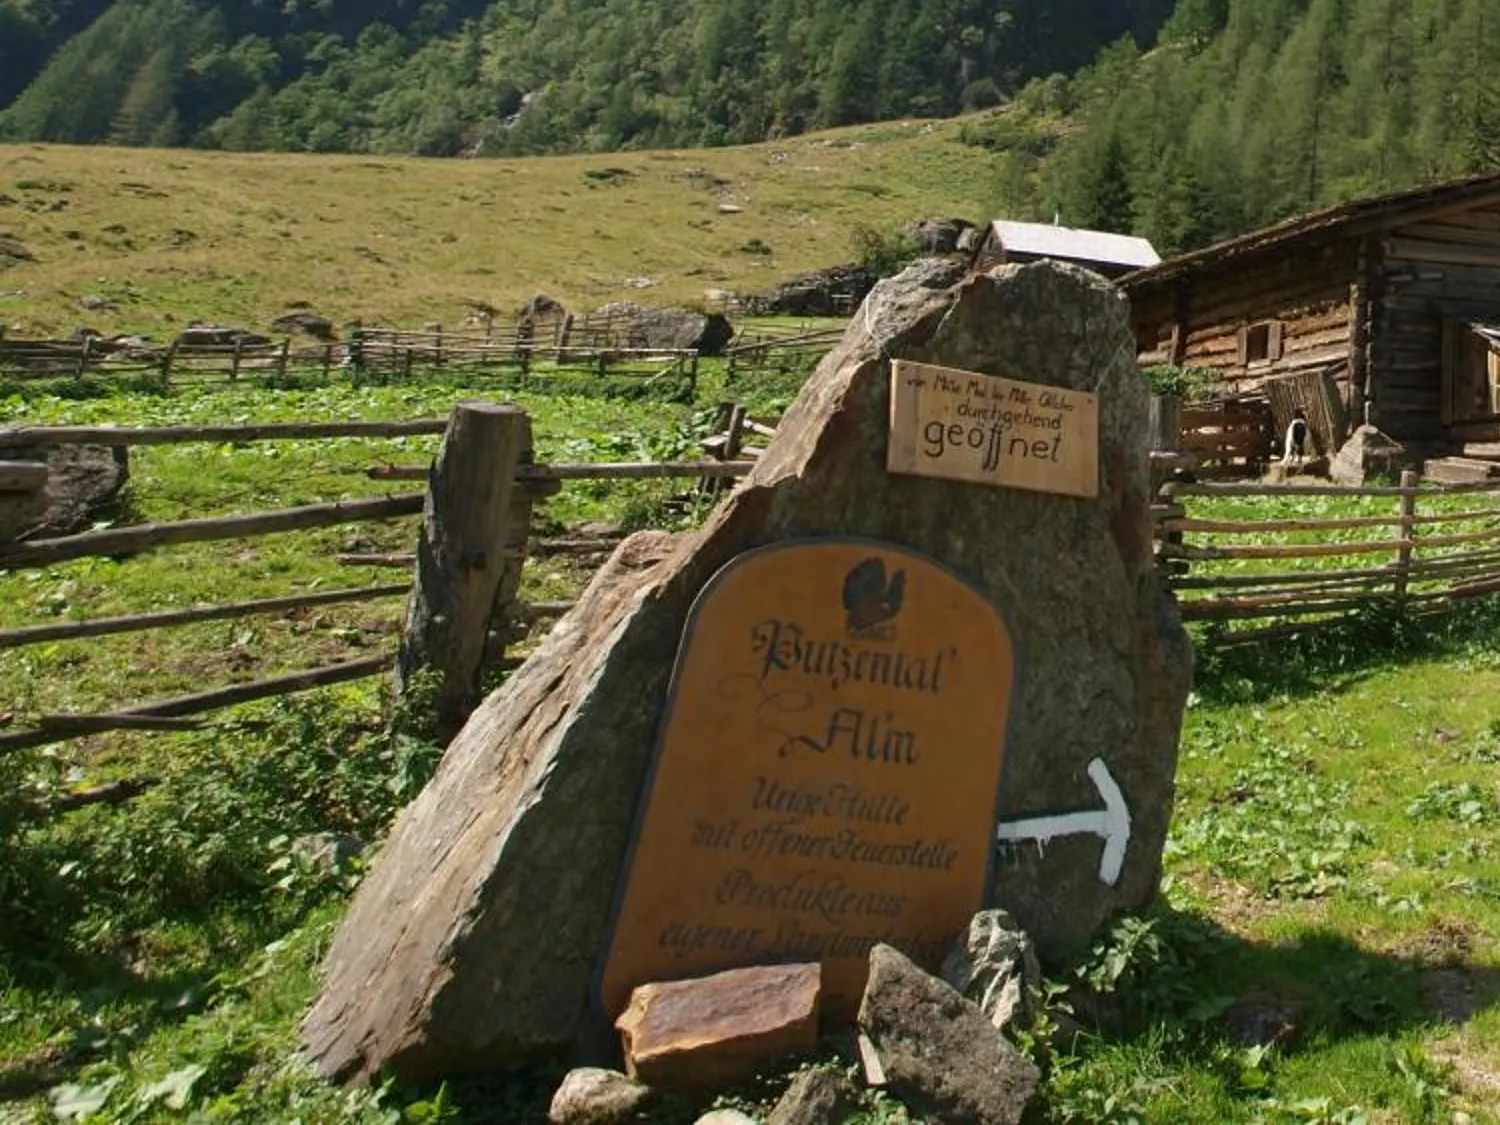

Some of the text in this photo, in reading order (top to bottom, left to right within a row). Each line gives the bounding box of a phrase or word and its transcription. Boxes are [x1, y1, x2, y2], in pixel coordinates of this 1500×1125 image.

[776, 706, 920, 764] Alm
[690, 818, 740, 850] mit
[830, 827, 959, 870] Feuerstelle
[714, 867, 855, 924] Produkte
